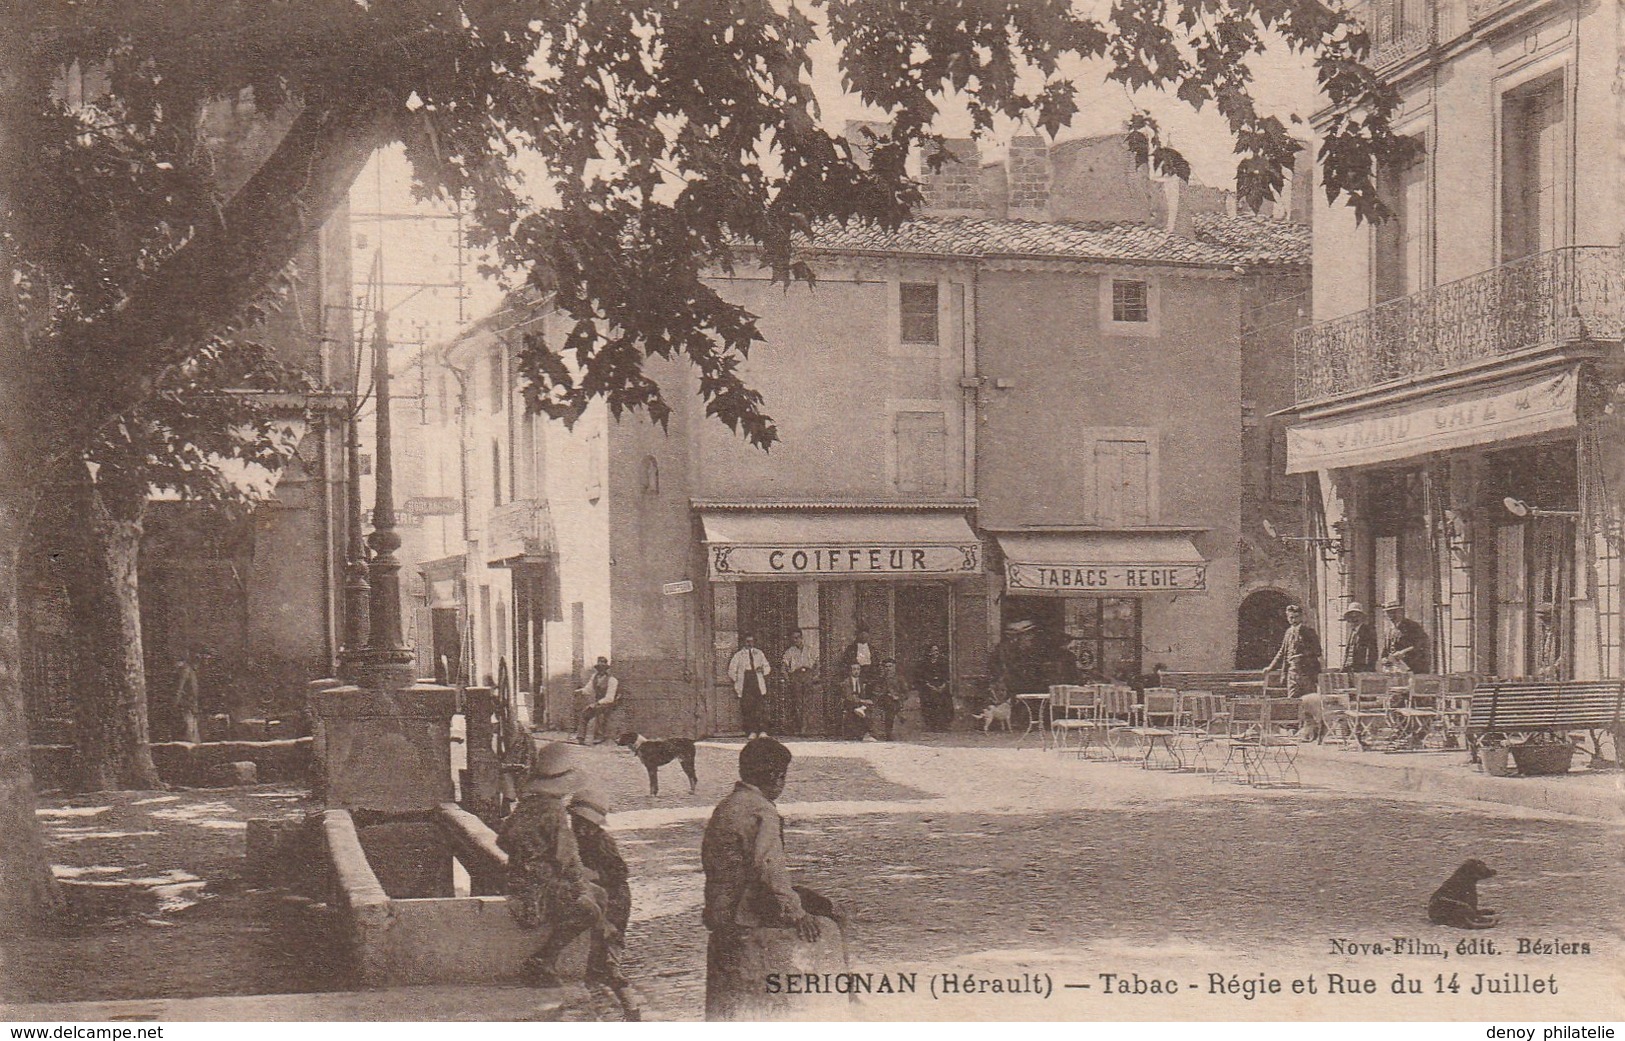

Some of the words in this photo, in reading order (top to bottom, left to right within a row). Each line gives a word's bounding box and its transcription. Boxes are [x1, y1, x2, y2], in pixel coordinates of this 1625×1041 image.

[769, 548, 928, 571] COIFFEUR
[1037, 567, 1108, 587] TABACS
[1127, 568, 1178, 587] REGIE
